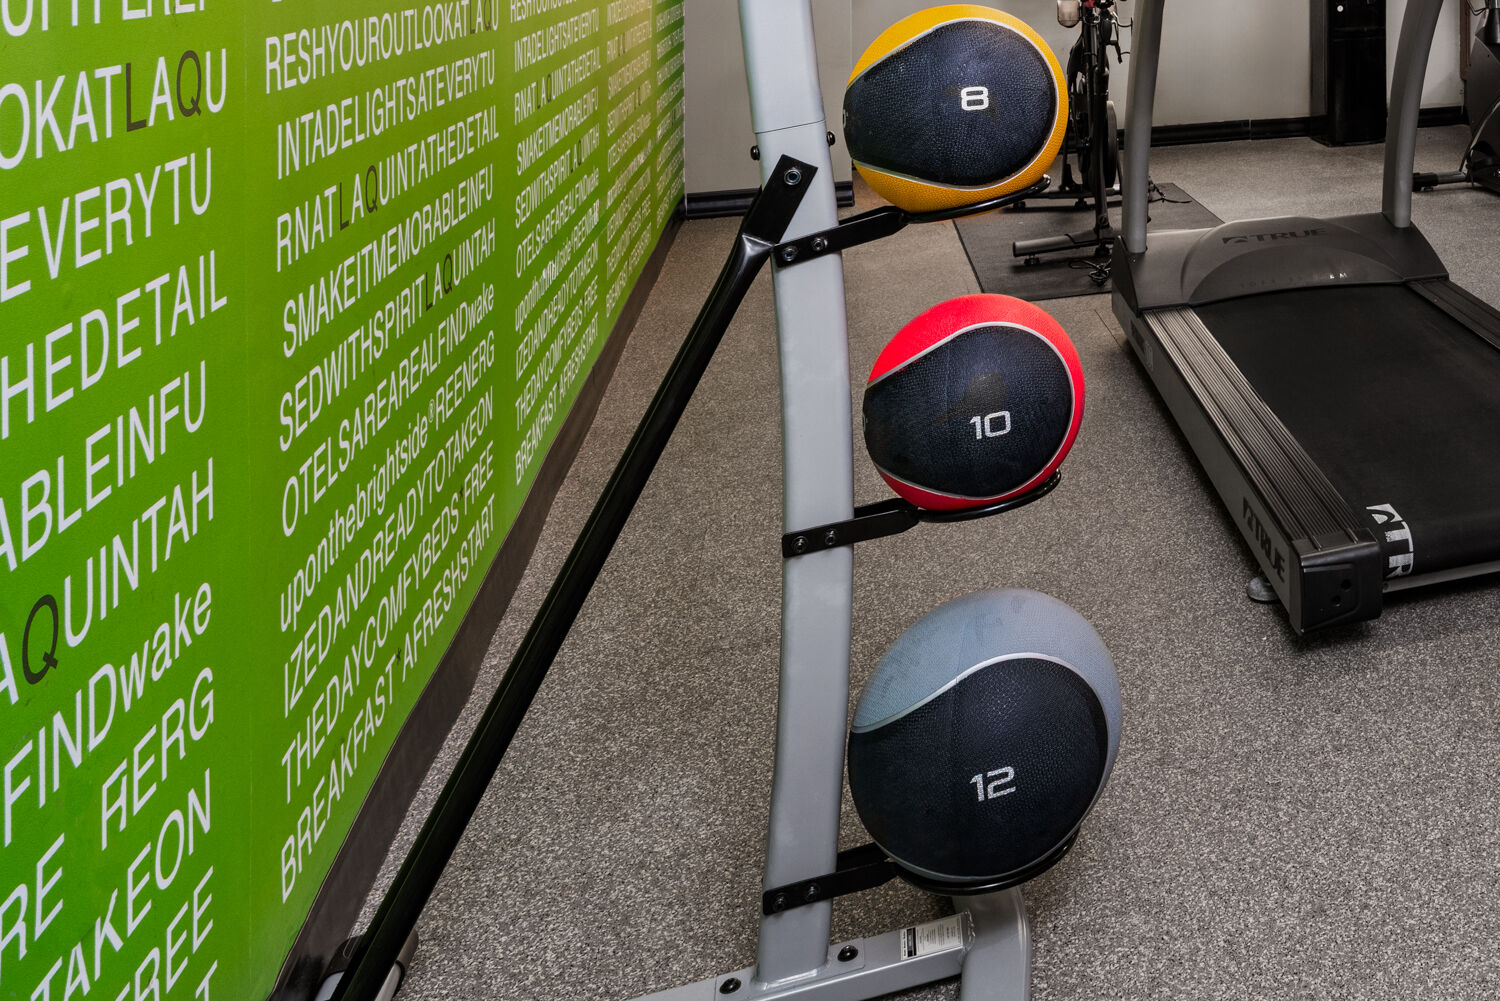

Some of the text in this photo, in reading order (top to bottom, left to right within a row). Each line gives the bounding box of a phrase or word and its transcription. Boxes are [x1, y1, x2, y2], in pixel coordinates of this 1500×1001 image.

[0, 48, 226, 170] OKATLAQU
[277, 49, 494, 180] INTADELIGHTSATEVERYTU
[960, 86, 989, 110] 8
[0, 147, 211, 303] EVERYTU
[277, 105, 499, 272] RNATLAQUINTATHEDETAIL
[283, 163, 493, 358] SMAKEITMEMORABLEINFU
[1248, 228, 1327, 243] TRUE
[0, 249, 227, 440] HEDETAIL
[280, 217, 495, 452] SEDWITHSPIRITLAQUINTAH
[282, 283, 494, 537] OTELSAREAREALFINDwake
[970, 411, 1011, 439] 10
[284, 386, 493, 719] IZEDANDREADYTOTAKEON
[1253, 514, 1285, 583] TRUE
[3, 582, 212, 848] FINDwake
[970, 767, 1015, 801] 12
[115, 865, 213, 1001] REE
